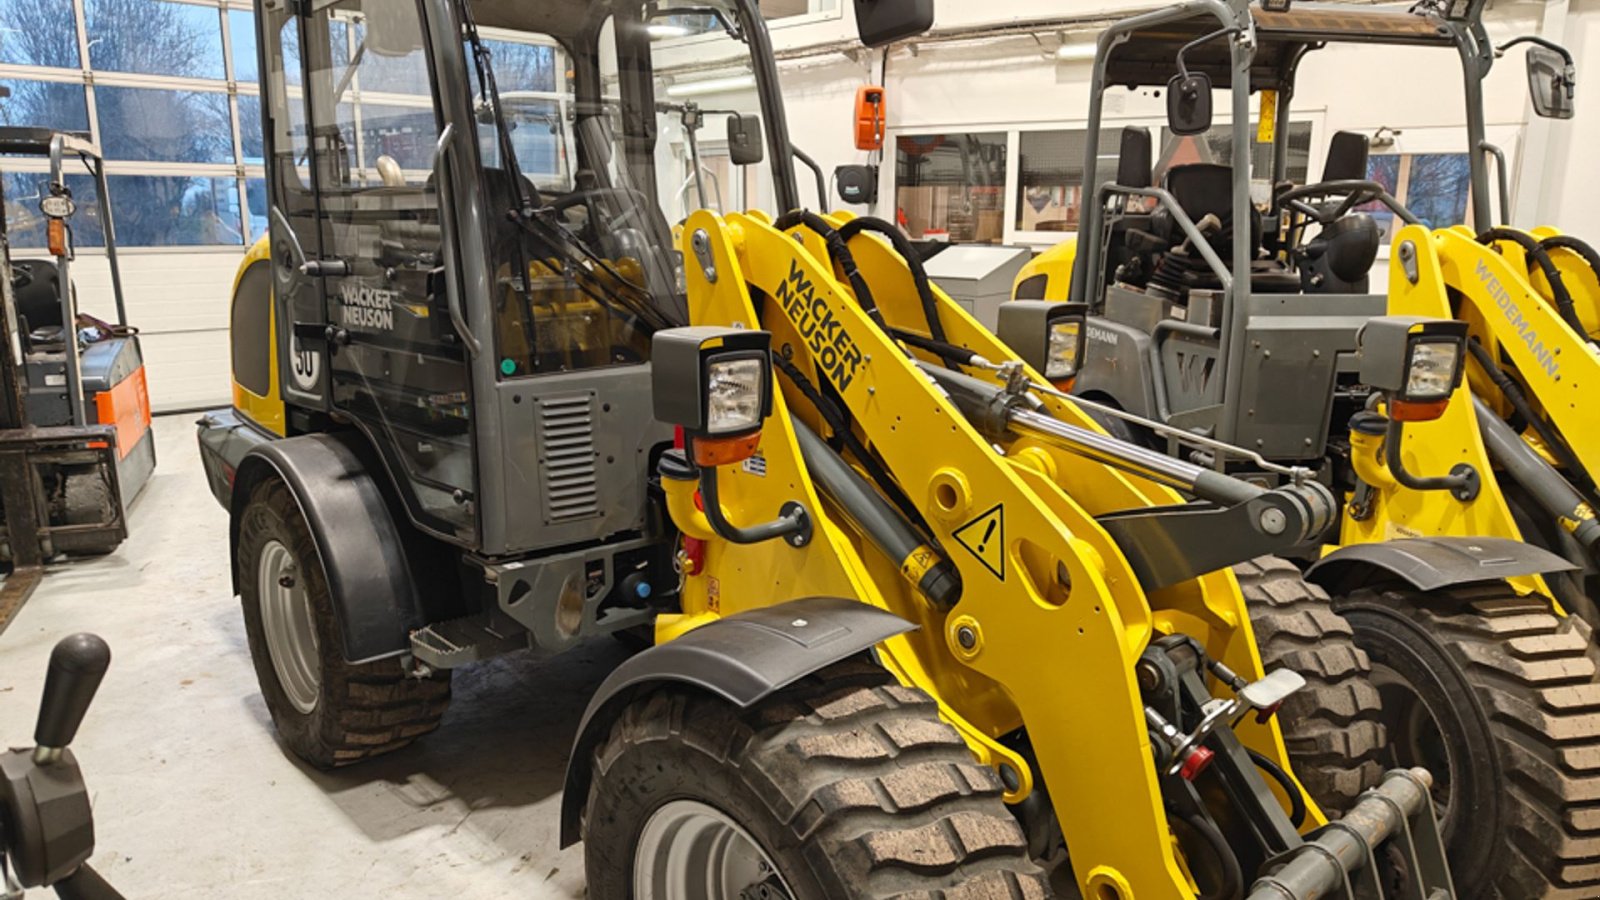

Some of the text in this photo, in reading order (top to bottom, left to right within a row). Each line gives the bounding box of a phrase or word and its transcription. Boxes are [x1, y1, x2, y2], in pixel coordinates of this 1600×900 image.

[341, 284, 392, 310] WACKER
[343, 305, 394, 330] NEUSON
[775, 278, 853, 393] NEUSON
[789, 258, 862, 374] WACKER
[1475, 258, 1559, 377] WEIDEMANN
